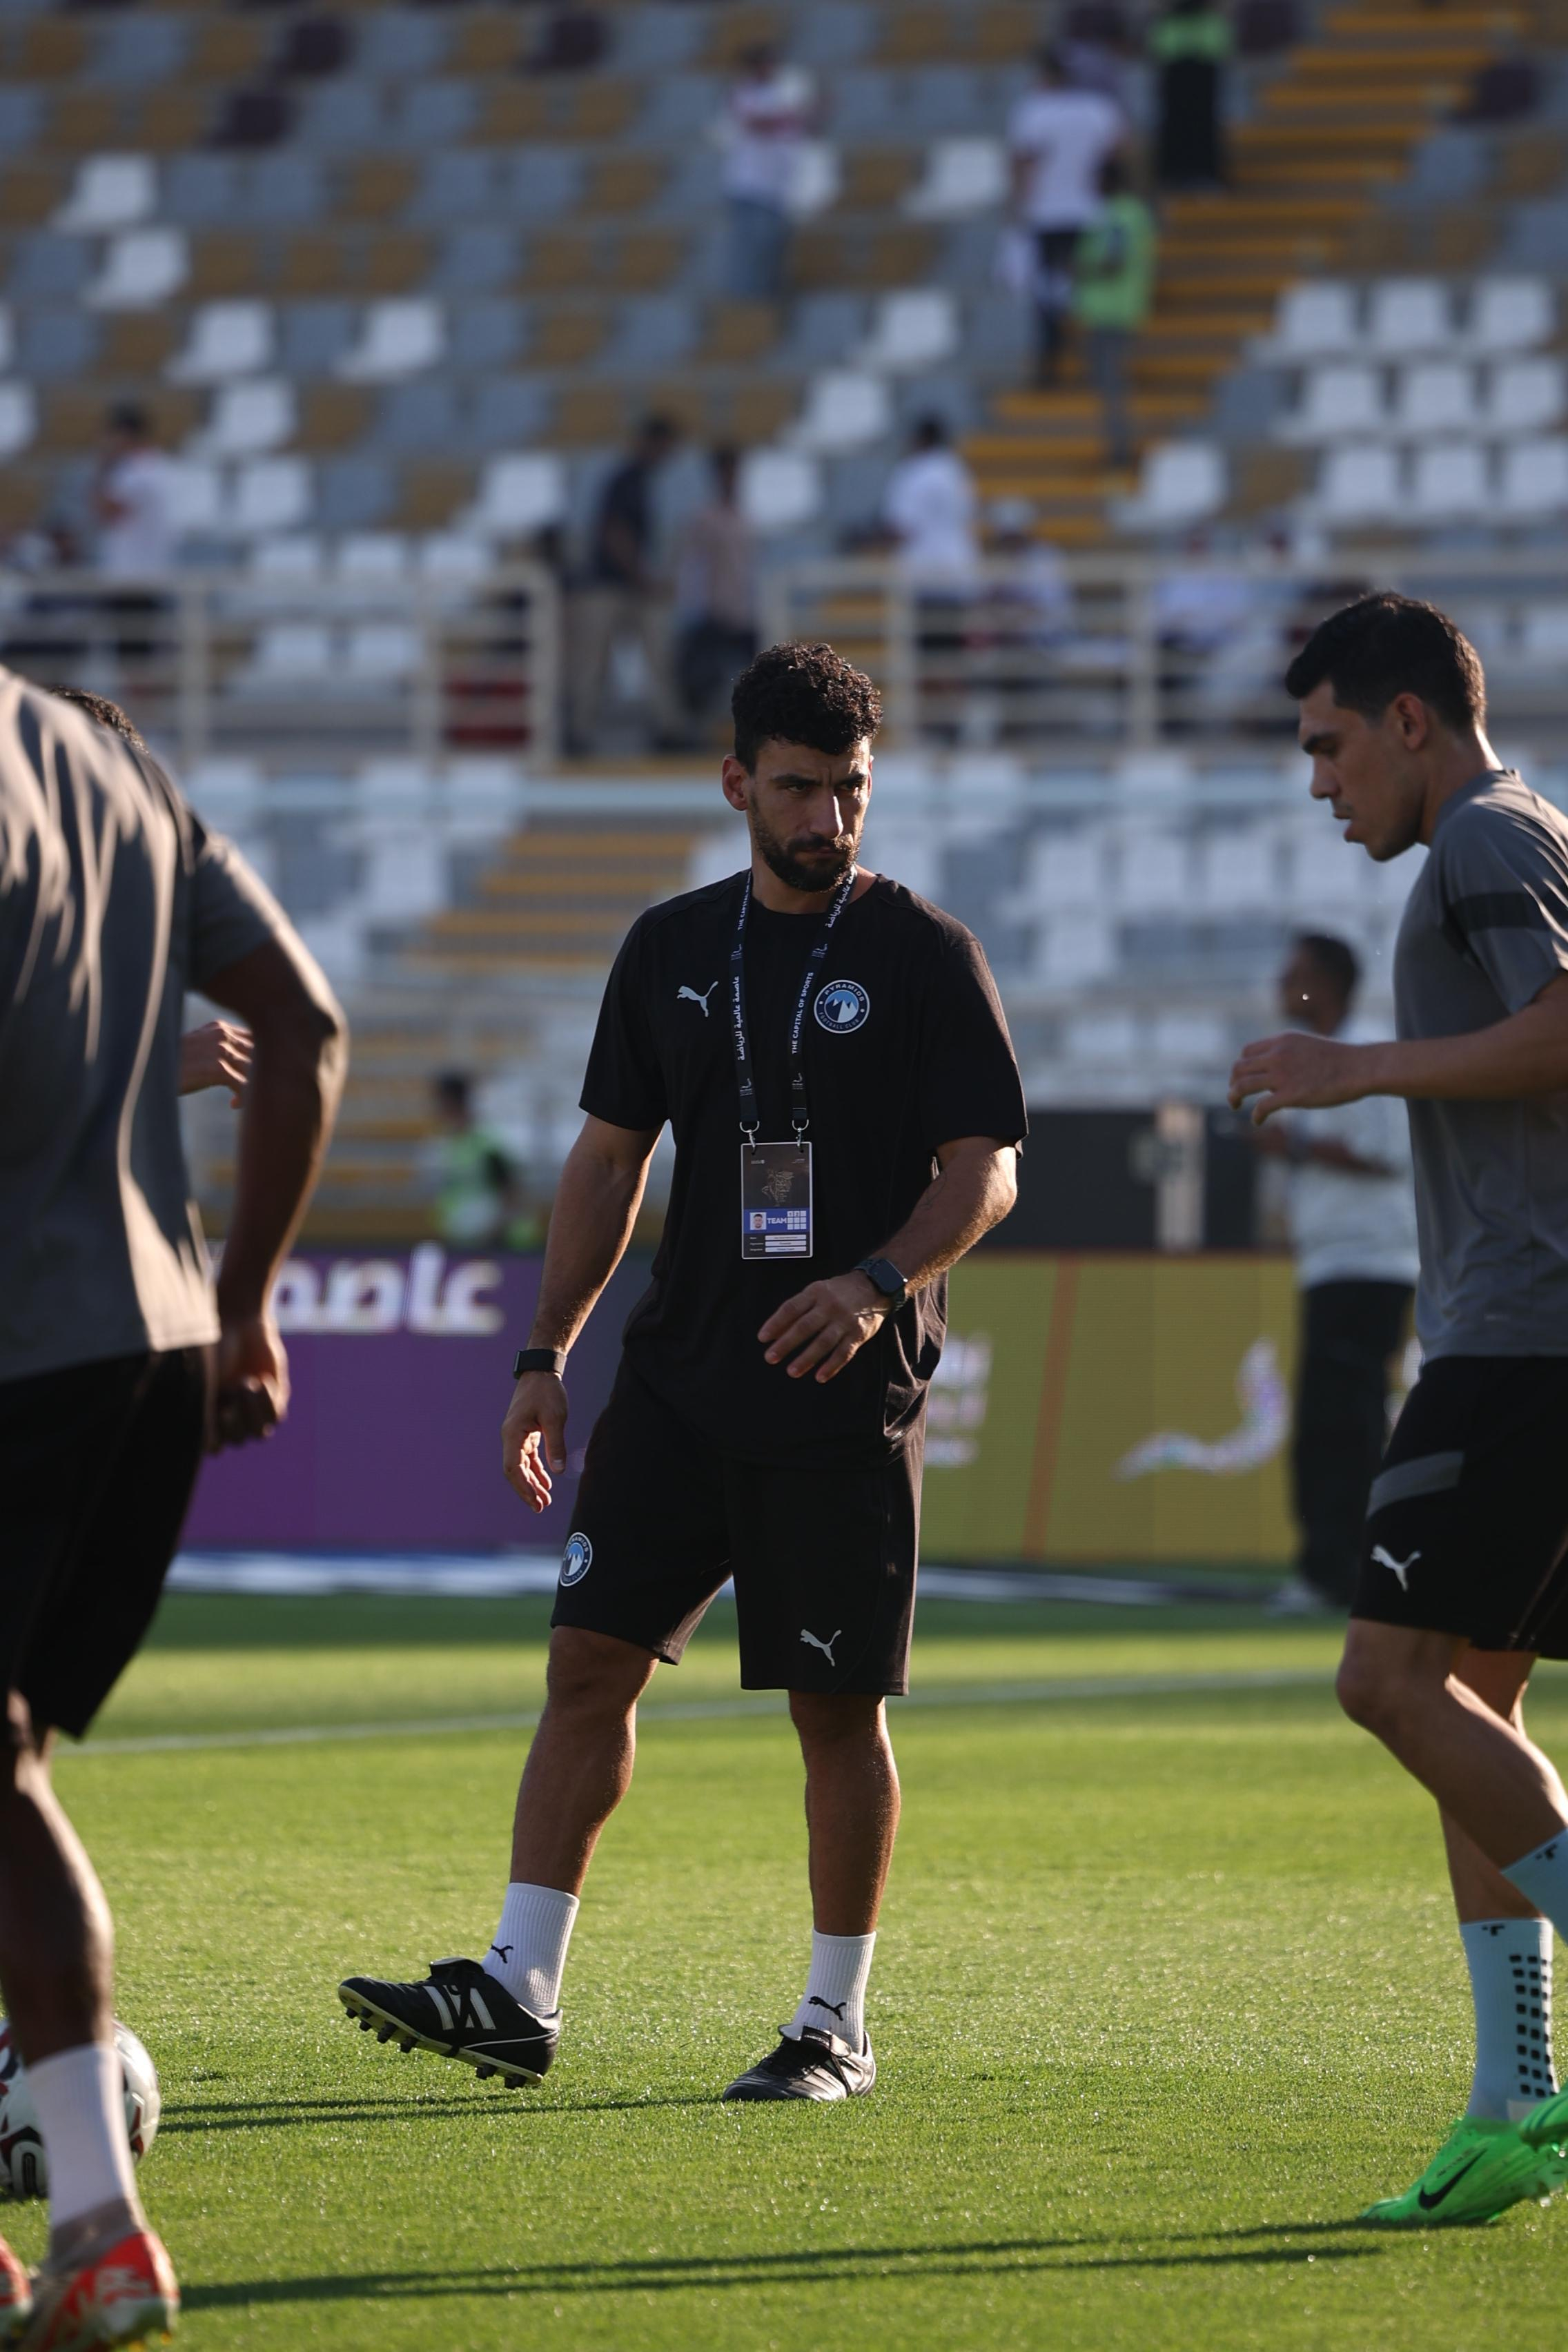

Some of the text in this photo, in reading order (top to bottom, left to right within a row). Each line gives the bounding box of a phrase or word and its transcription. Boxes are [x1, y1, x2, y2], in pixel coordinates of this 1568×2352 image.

[836, 884, 851, 904] عالمية
[824, 903, 842, 928] للرياضة
[801, 972, 814, 997] SPORTS
[823, 983, 865, 1001] PYRAMIDS
[798, 998, 805, 1008] OF
[732, 975, 745, 1061] عاصمة عالمية للرياضة
[792, 1010, 804, 1039] CAPITAL
[819, 1012, 860, 1030] FOOTBALL CLUB
[271, 1241, 505, 1335] عاصم
